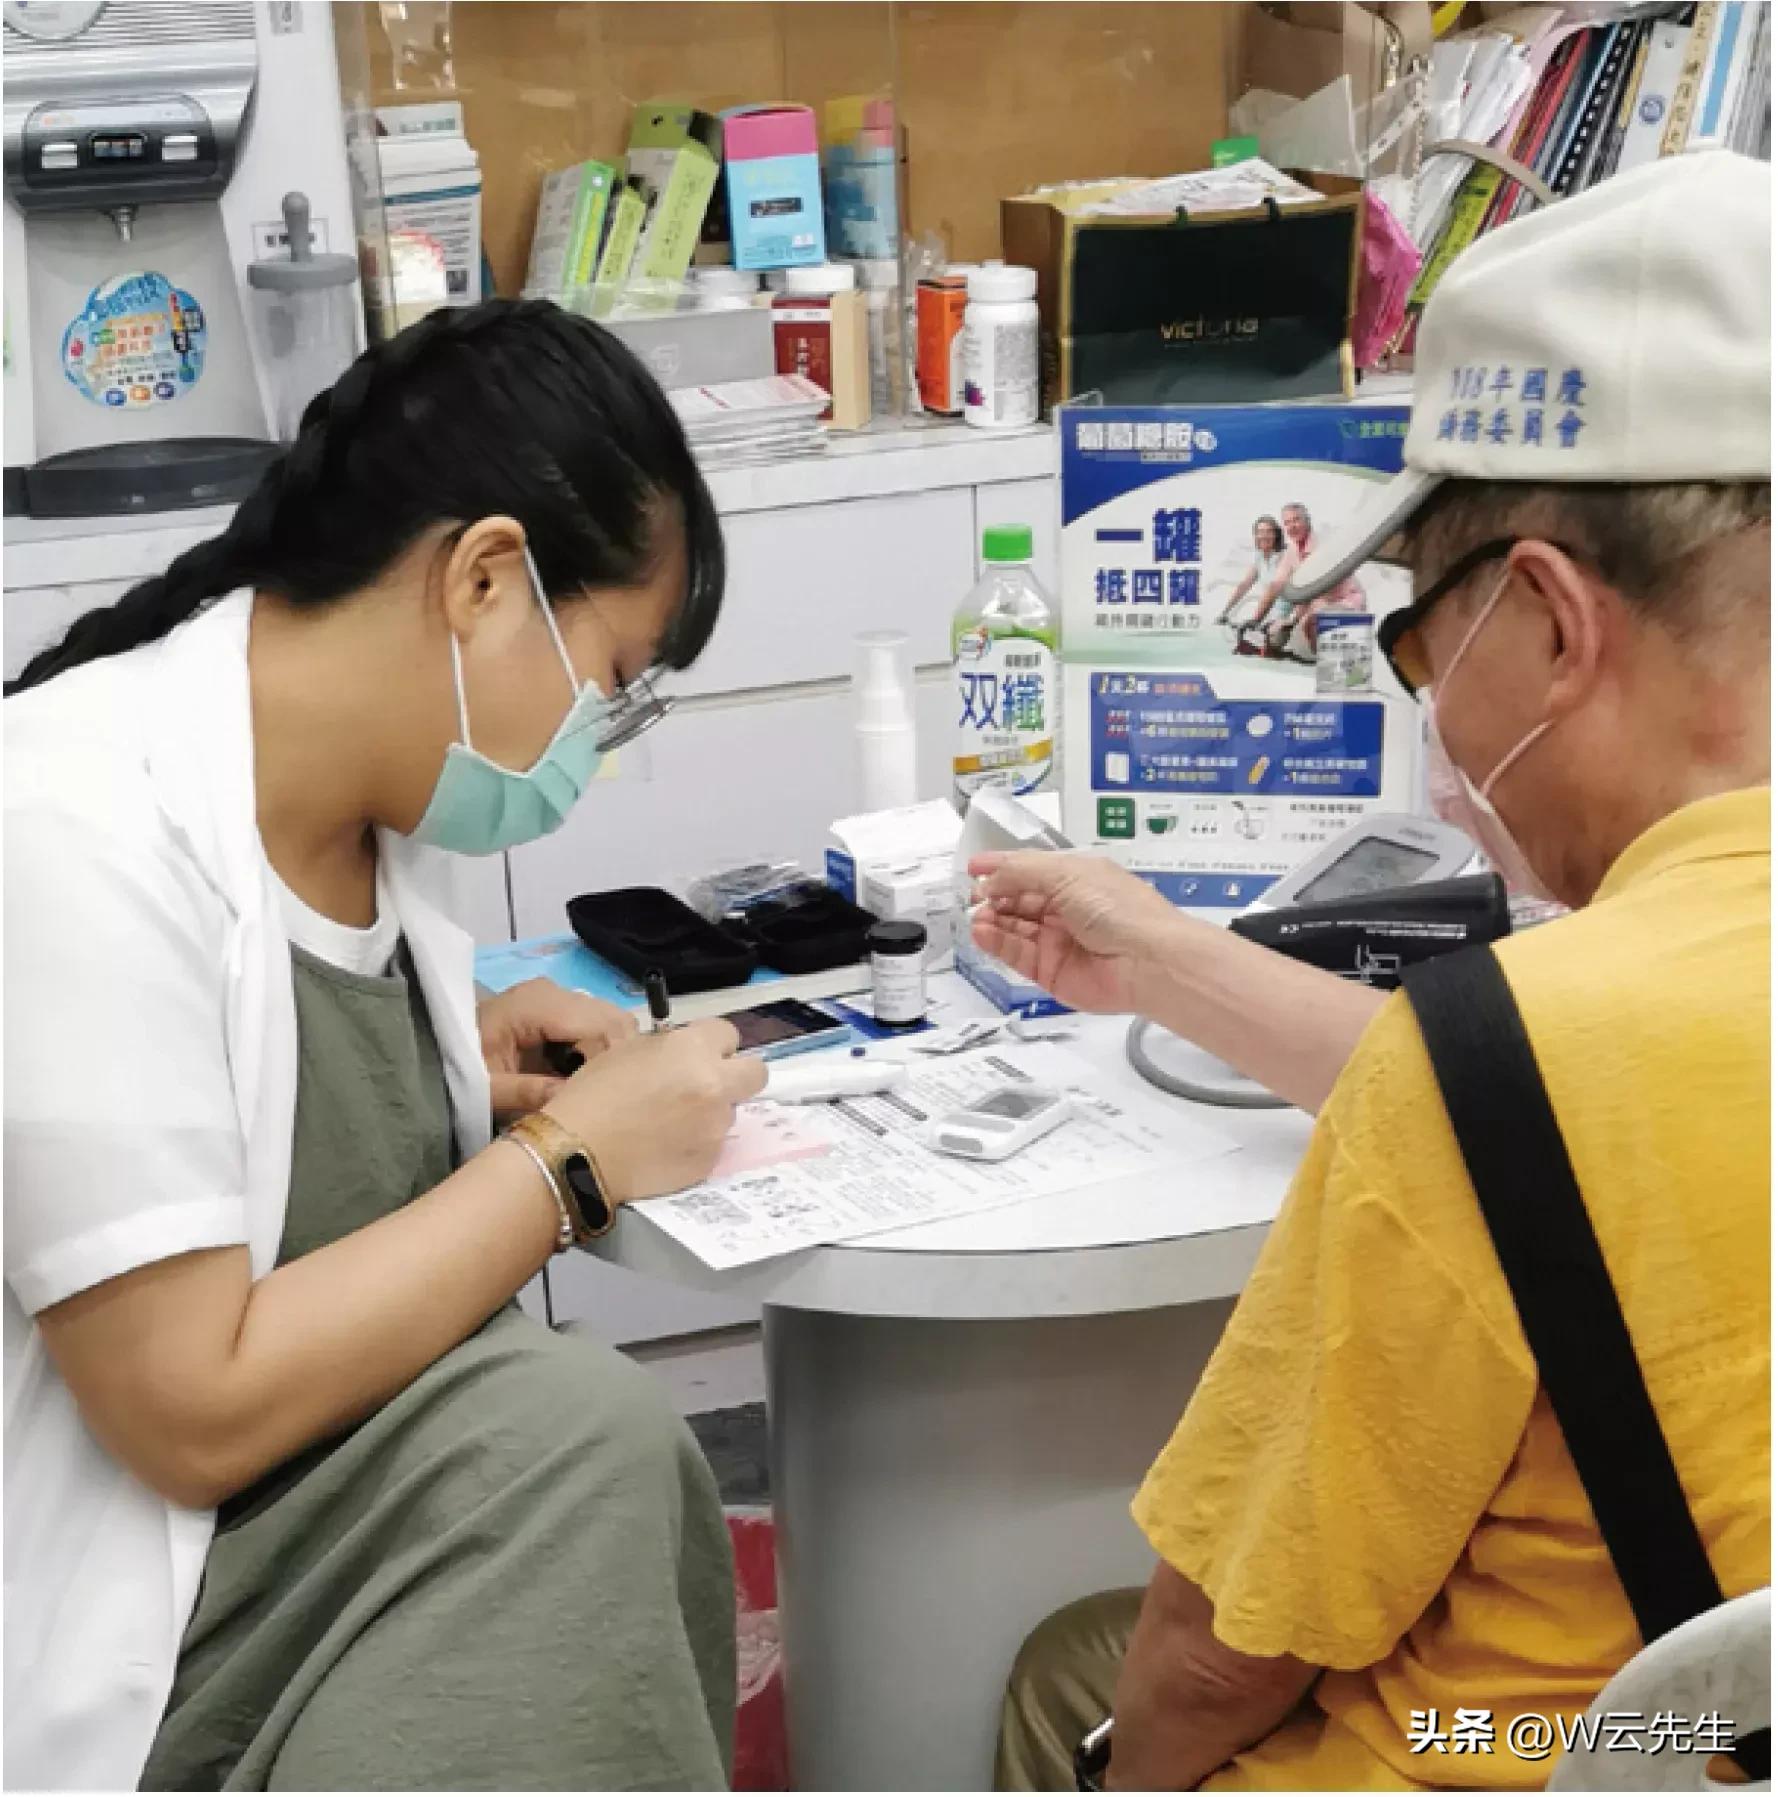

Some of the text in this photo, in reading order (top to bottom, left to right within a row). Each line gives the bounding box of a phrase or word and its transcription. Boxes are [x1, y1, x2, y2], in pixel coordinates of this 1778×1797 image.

[1095, 507, 1202, 563] 一罐
[1095, 567, 1201, 605] 抵四罐
